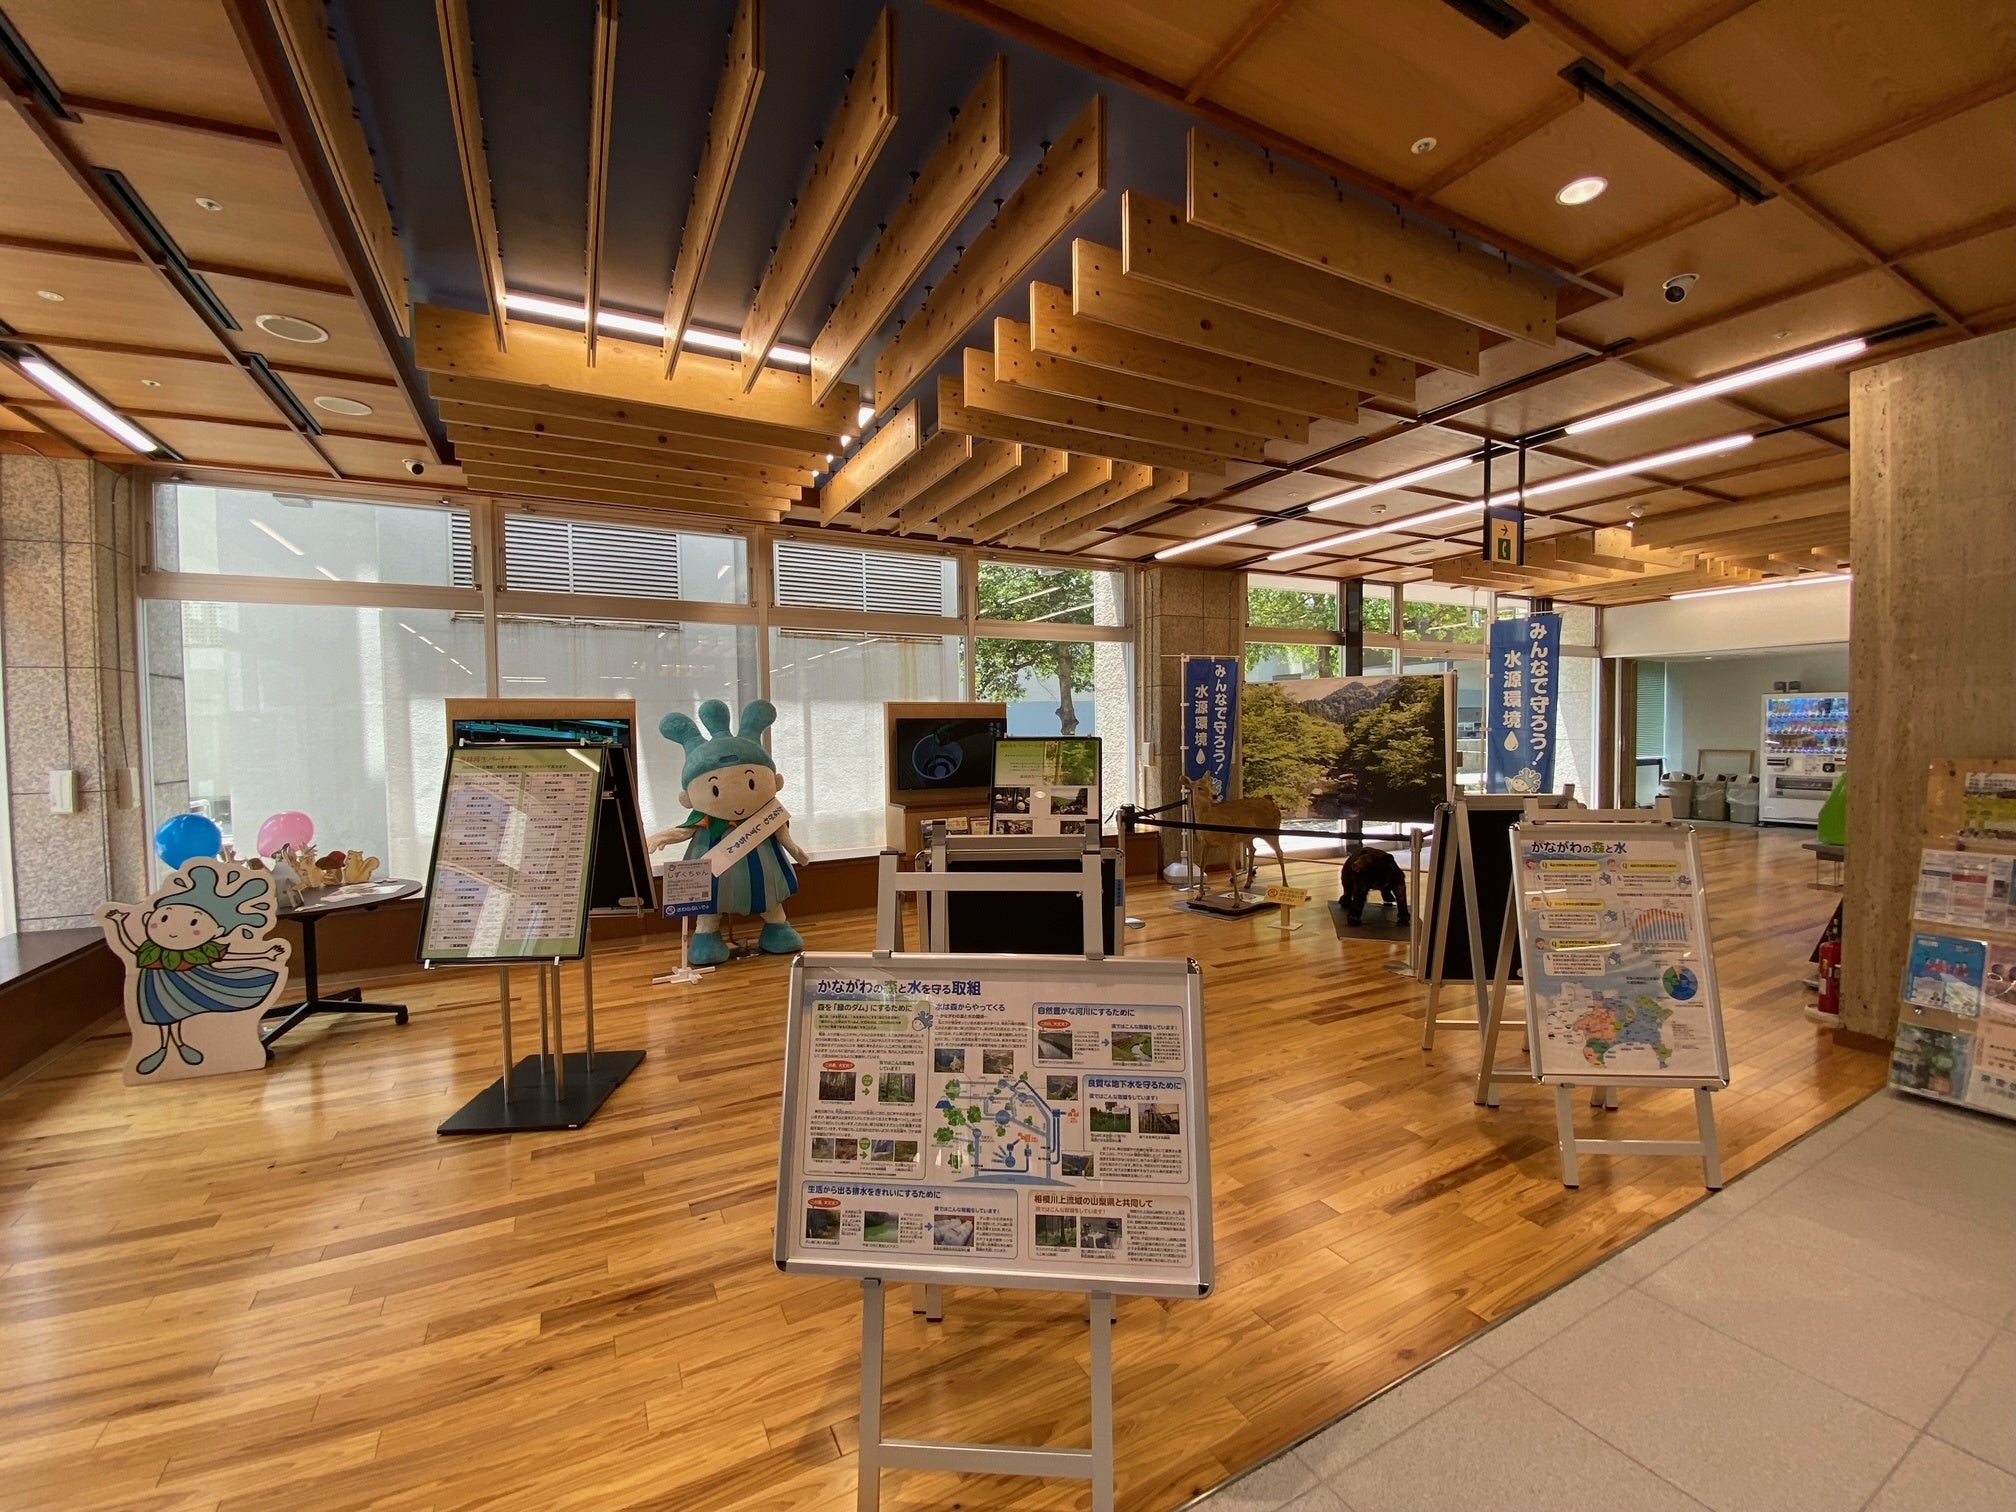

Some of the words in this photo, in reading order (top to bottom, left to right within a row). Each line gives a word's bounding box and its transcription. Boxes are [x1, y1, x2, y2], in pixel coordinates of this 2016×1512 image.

[1502, 649, 1522, 729] 水源環境
[1529, 622, 1549, 766] みんなで守ろう！
[1195, 684, 1209, 747] 水源環境
[1213, 664, 1227, 775] みんなで守ろう！
[1531, 841, 1627, 854] かながわの森と水
[667, 870, 709, 879] しずくちゃん
[818, 980, 981, 996] かながわの森と水を守る取組
[1038, 1006, 1135, 1017] 自然豊かな河川にするために
[1088, 1079, 1182, 1090] 良質な地下水を守るために
[808, 1185, 941, 1199] 生活から出る排水をきれいにするために
